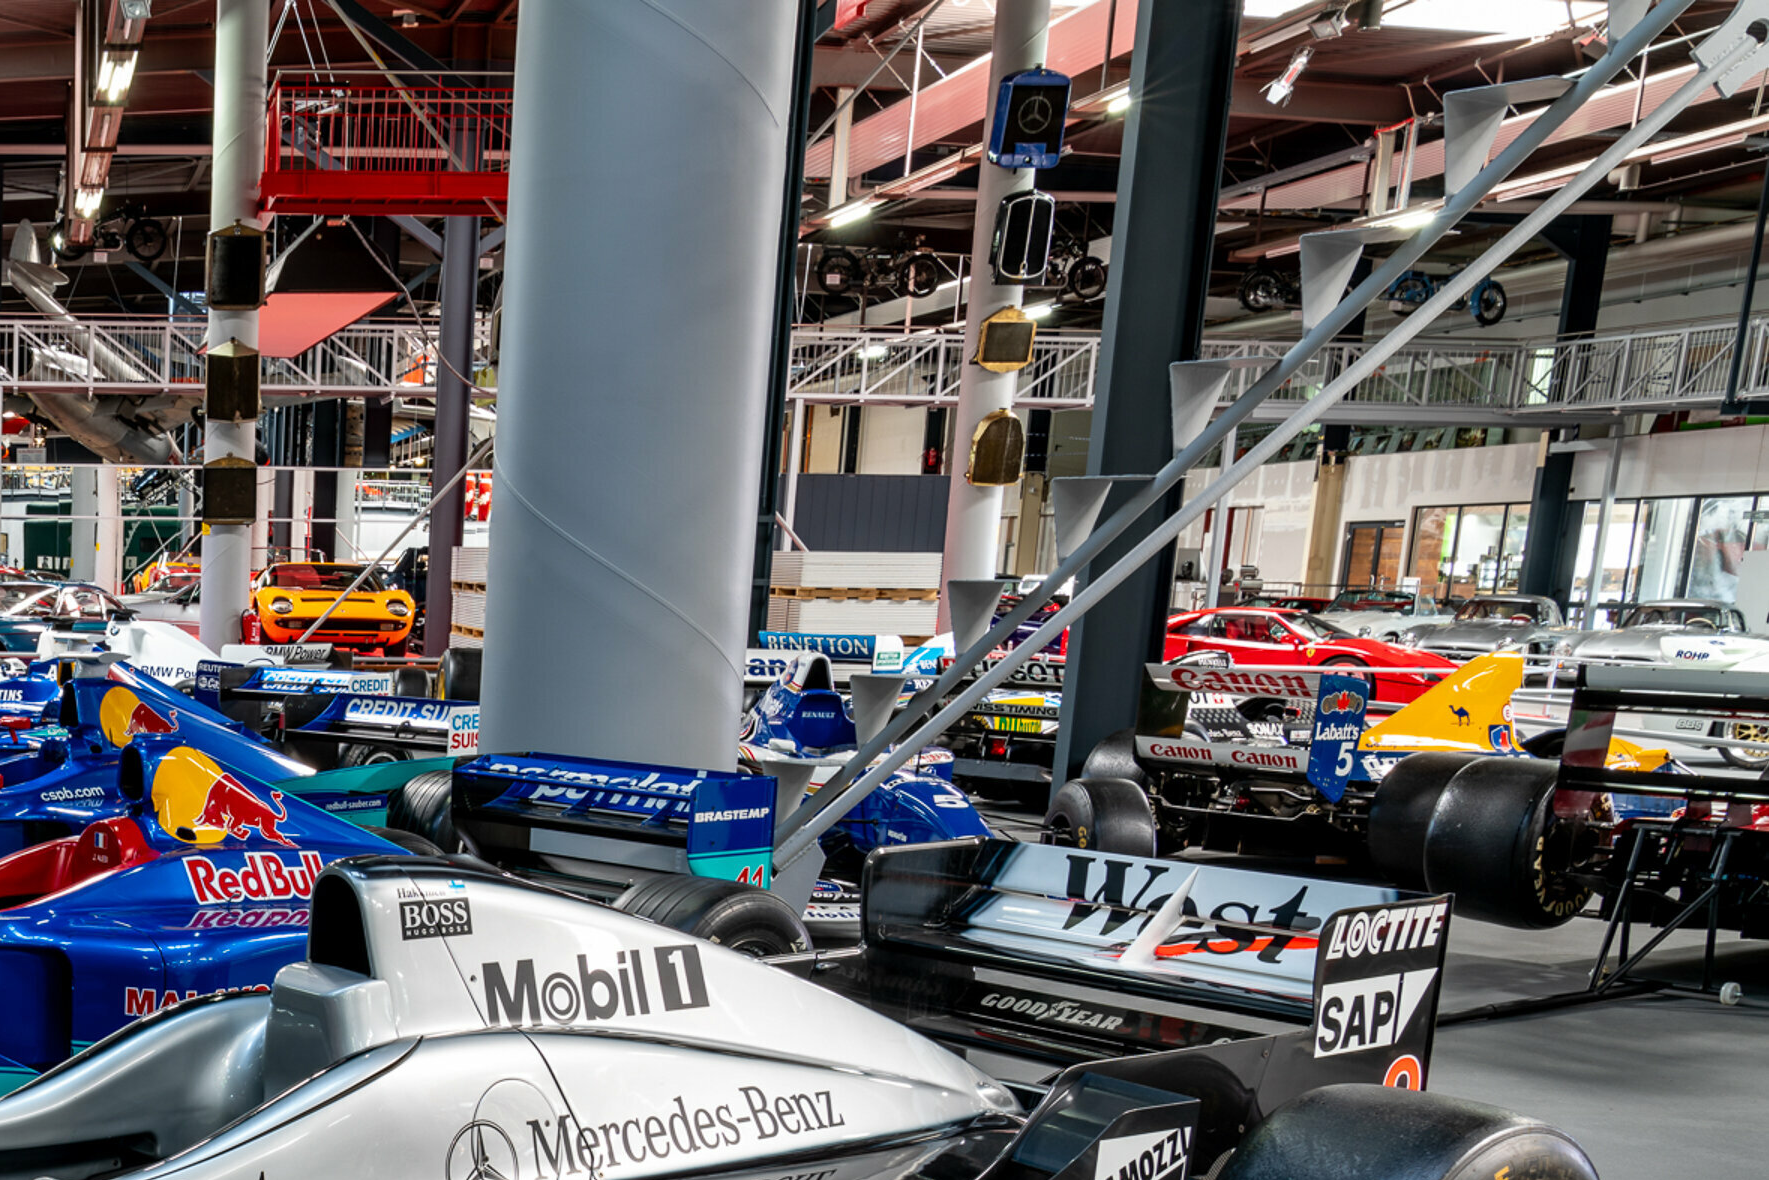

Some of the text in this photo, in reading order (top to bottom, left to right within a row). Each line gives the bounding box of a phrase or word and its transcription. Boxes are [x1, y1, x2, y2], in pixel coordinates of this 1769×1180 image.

[292, 646, 327, 661] Power
[767, 635, 869, 655] BENETTON
[139, 665, 173, 677] BMW
[351, 678, 390, 693] CREDIT
[1171, 668, 1312, 698] Canon
[801, 711, 835, 719] RENAULT
[1008, 704, 1057, 717] TIMING
[1246, 722, 1285, 736] SONAX
[1315, 722, 1360, 741] Labatt's
[1150, 743, 1298, 769] Canon Canon
[1335, 742, 1355, 777] 5
[40, 785, 106, 802] cspb.com
[693, 807, 770, 824] BRASTEMP
[403, 901, 468, 928] BOSS
[1061, 854, 1309, 965] West
[406, 925, 469, 936] HUGO BOSS
[1325, 903, 1447, 961] LOCTITE
[482, 947, 704, 1028] Mobil 1
[1319, 989, 1396, 1053] SAP
[527, 1086, 846, 1180] Mercedes-Benz
